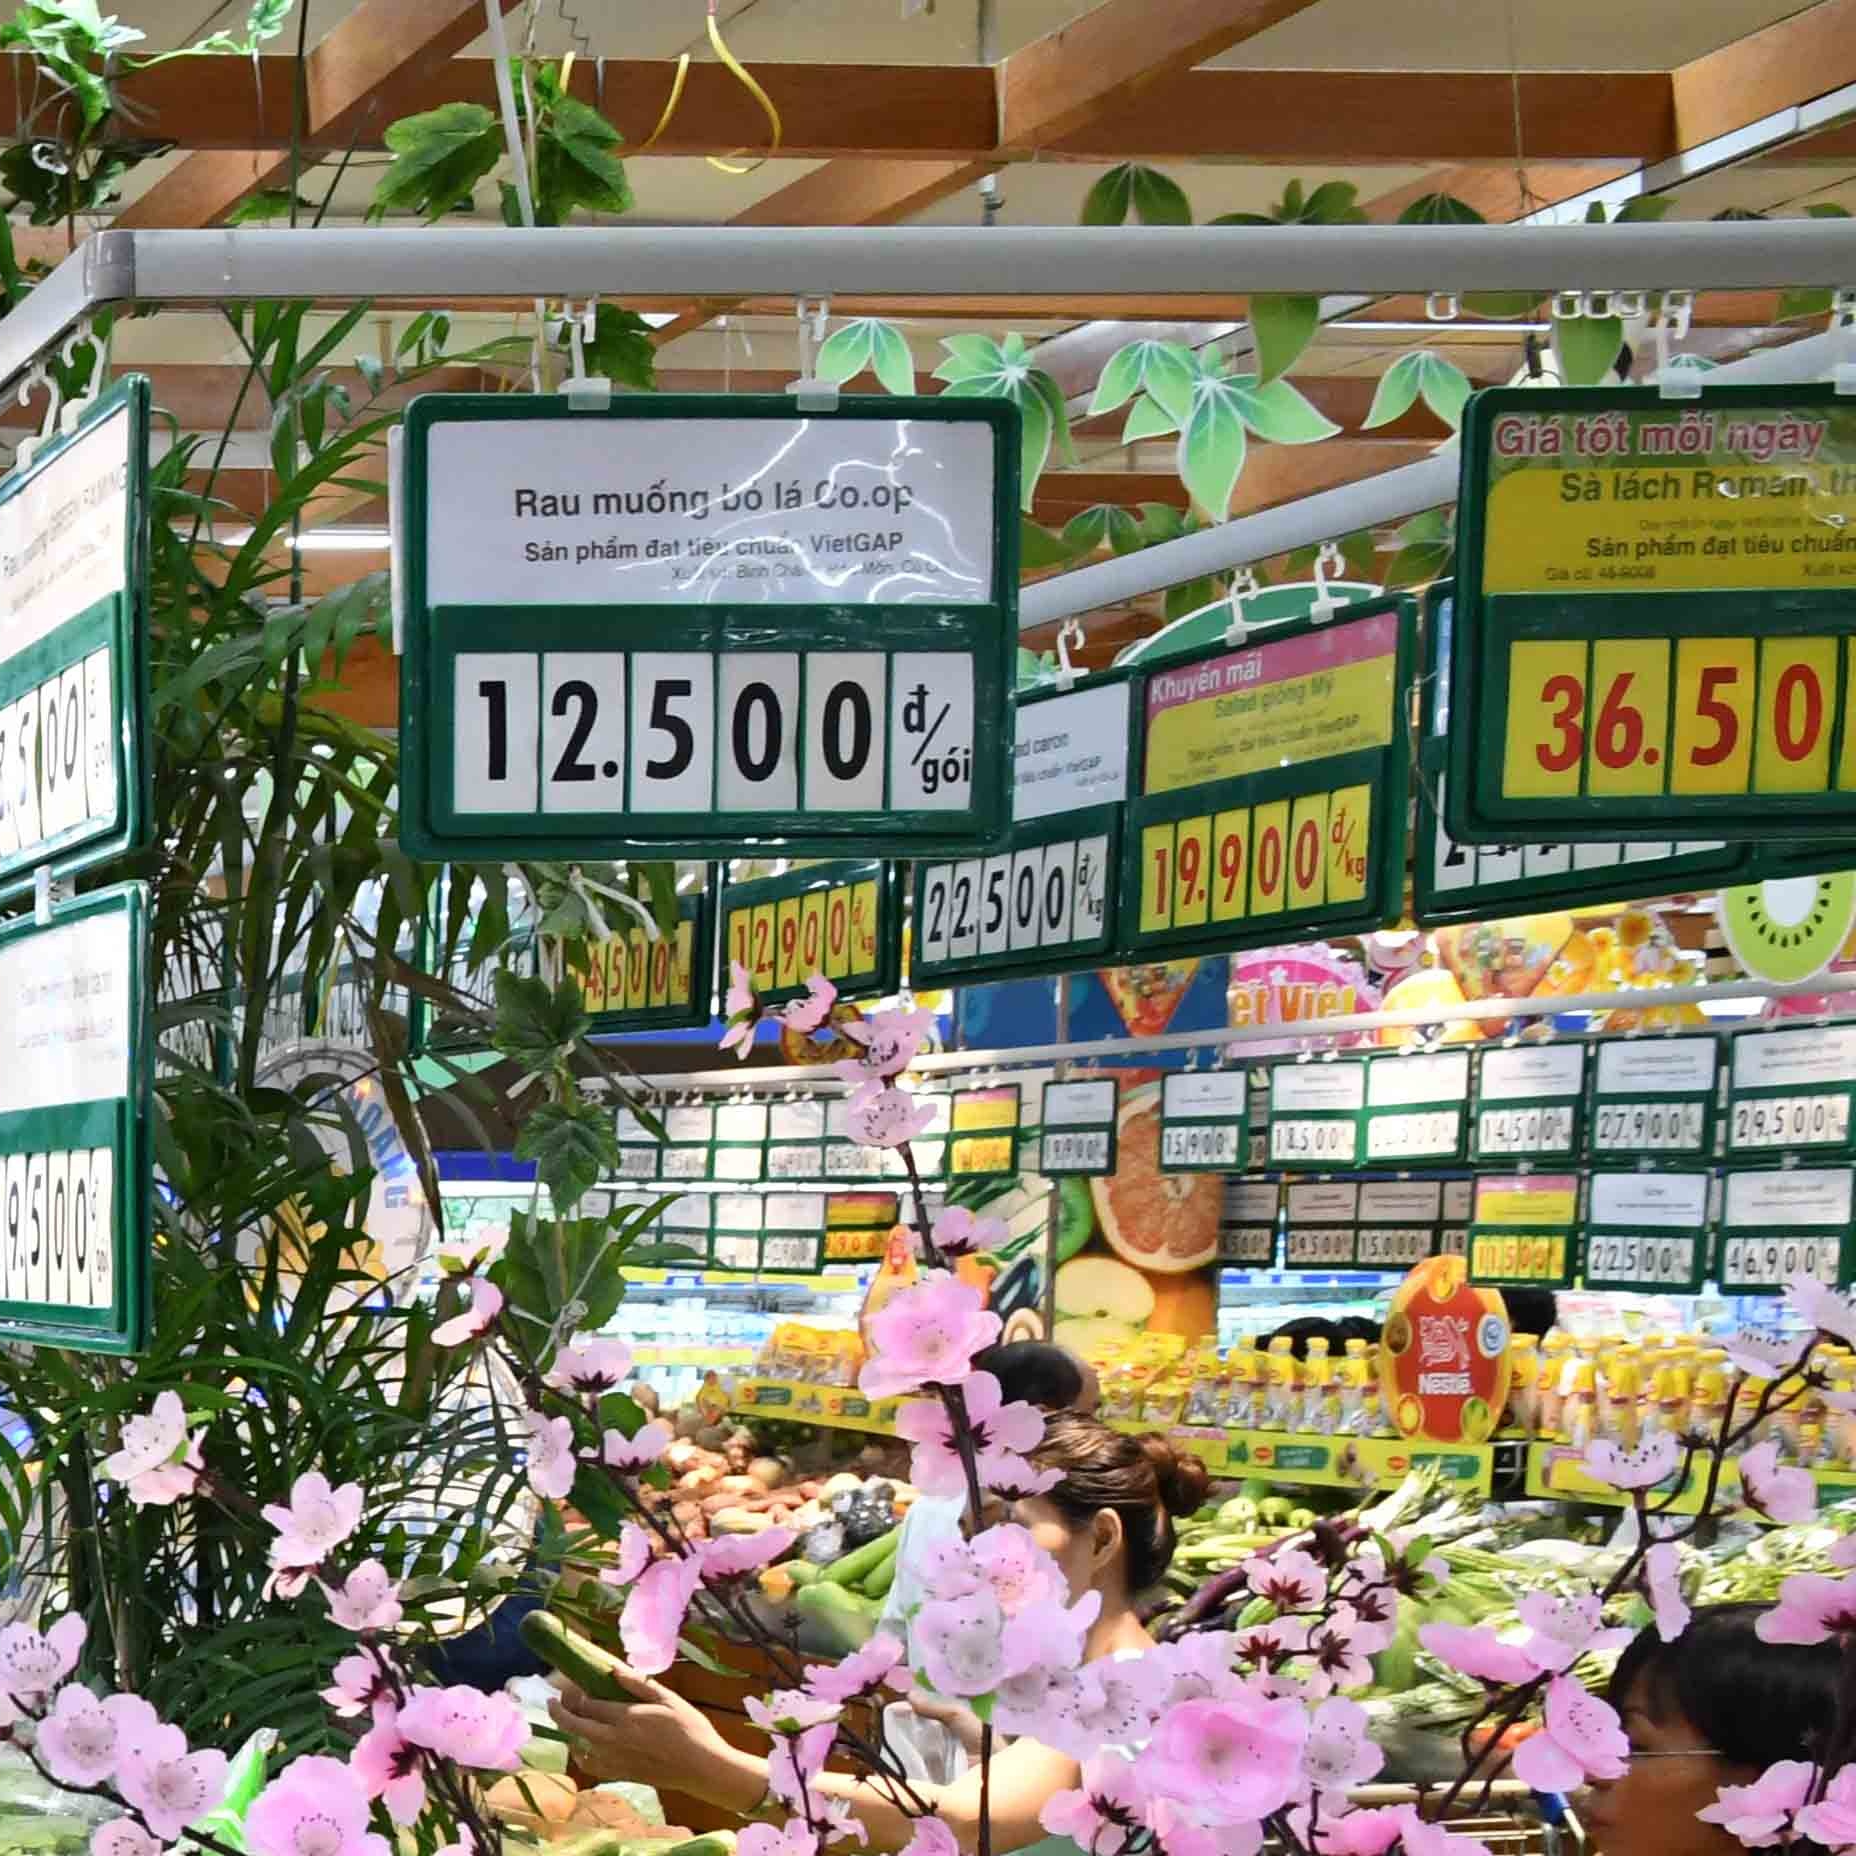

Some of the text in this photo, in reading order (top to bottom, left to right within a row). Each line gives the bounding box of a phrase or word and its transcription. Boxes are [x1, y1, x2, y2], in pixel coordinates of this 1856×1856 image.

[1495, 408, 1826, 462] Giá tốt mỗi ngày
[513, 480, 914, 520] Rau muống lá Co.op
[1613, 471, 1681, 502] lách
[524, 541, 569, 564] Sản
[575, 536, 639, 567] phẩm
[645, 537, 681, 562] đạt
[810, 531, 905, 555] VietGAP
[1586, 535, 1628, 559] Sản
[1635, 531, 1696, 561] phẩm
[1702, 533, 1737, 560] đạt
[1743, 532, 1785, 556] tiêu
[1150, 651, 1263, 704] Khuyến mãi
[478, 680, 873, 785] 12.500
[1154, 818, 1319, 915] 19.900
[926, 861, 1065, 945] 22.500
[1598, 1110, 1680, 1142] 27.900
[1736, 1104, 1824, 1137] 29.500
